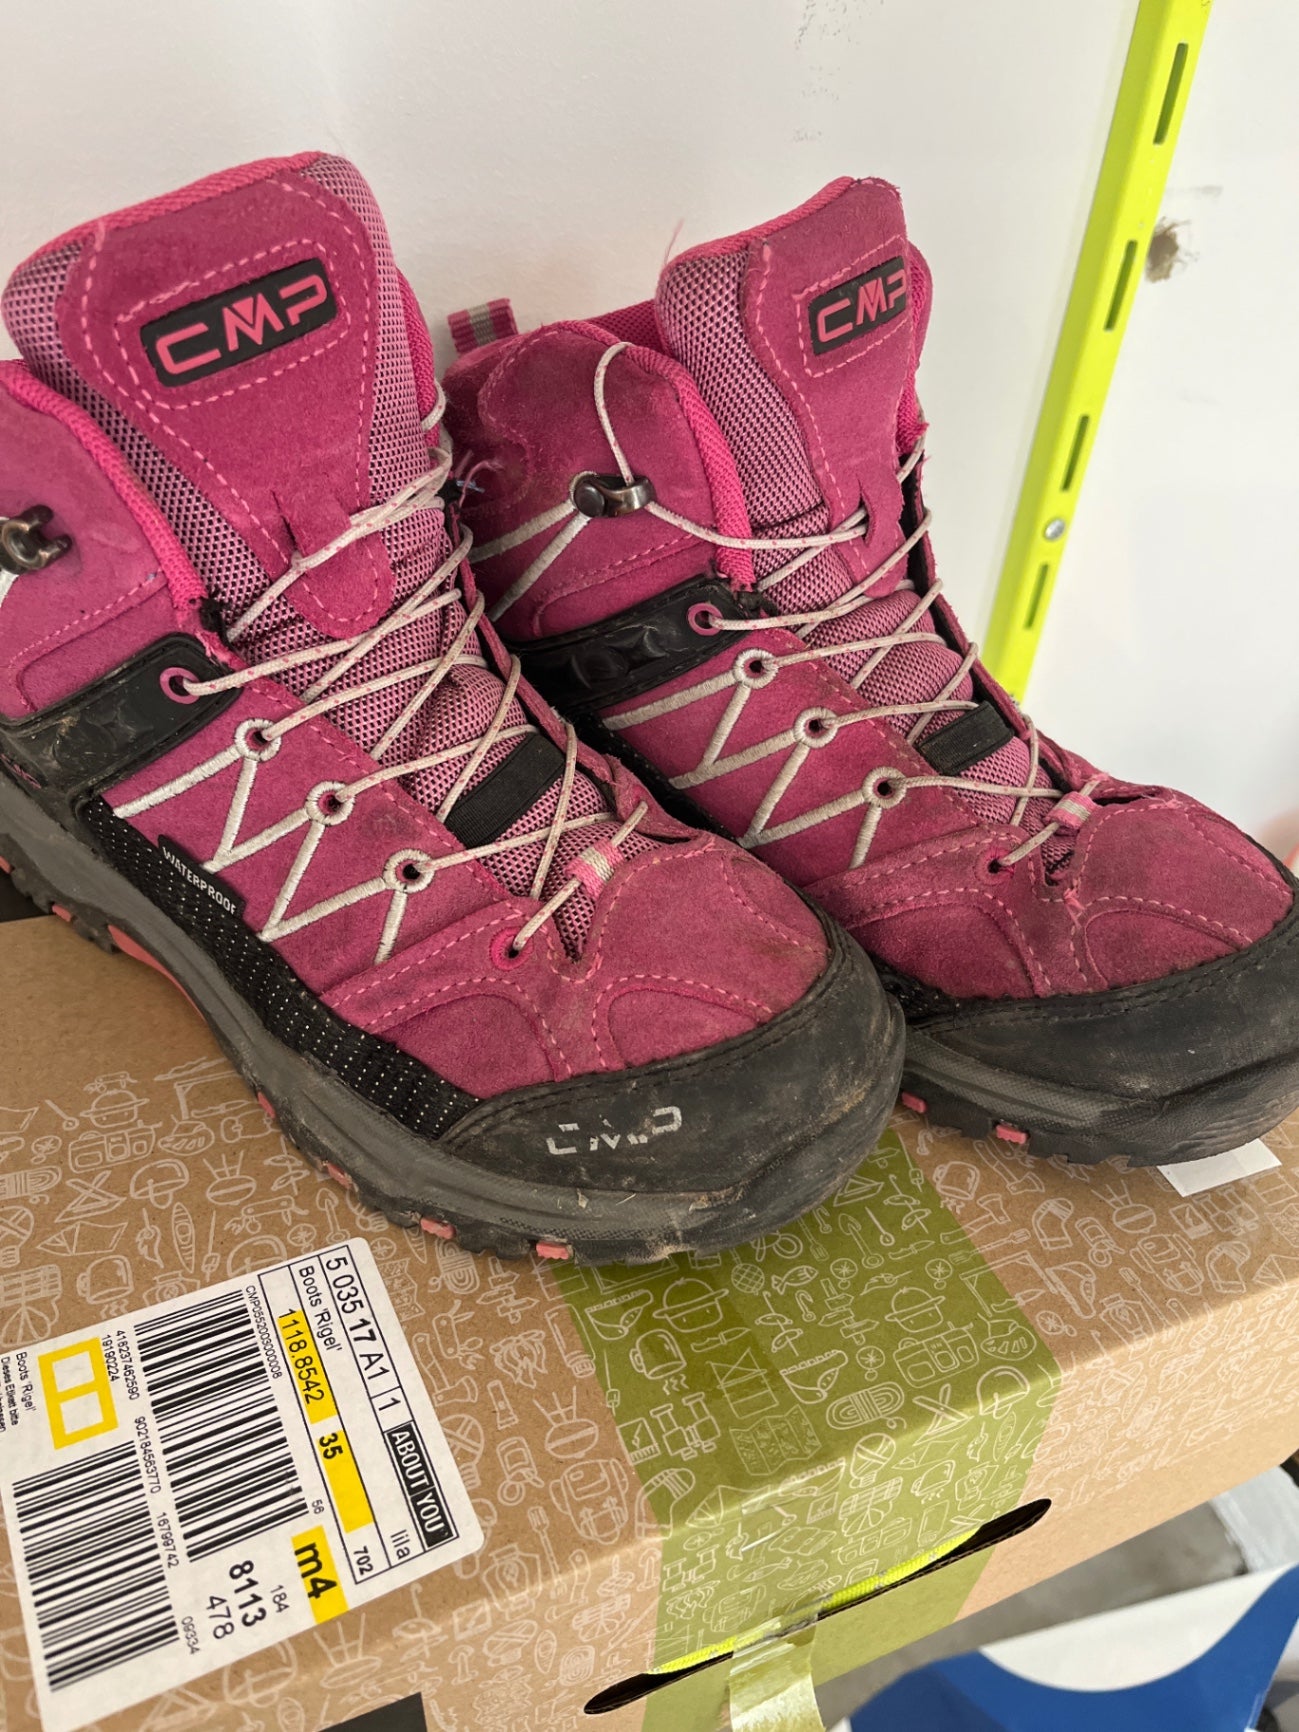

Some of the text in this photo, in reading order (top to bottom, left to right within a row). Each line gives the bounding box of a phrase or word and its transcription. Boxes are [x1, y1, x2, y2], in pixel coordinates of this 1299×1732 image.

[156, 274, 328, 375] CMP
[817, 269, 907, 342] CMP
[162, 846, 237, 915] WATERPROOF
[299, 1265, 343, 1351] Boots 'Rigel'
[325, 1257, 401, 1411] 5 035 17 A1 1
[16, 1351, 30, 1381] Boots
[279, 1309, 374, 1575] 1118.8542 35 702
[392, 1431, 430, 1489] ABOUT
[311, 1499, 325, 1514] 56
[294, 1542, 337, 1600] m4
[390, 1529, 410, 1560] lila
[206, 1595, 235, 1640] 478
[229, 1560, 267, 1627] 8113
[270, 1585, 290, 1613] 184
